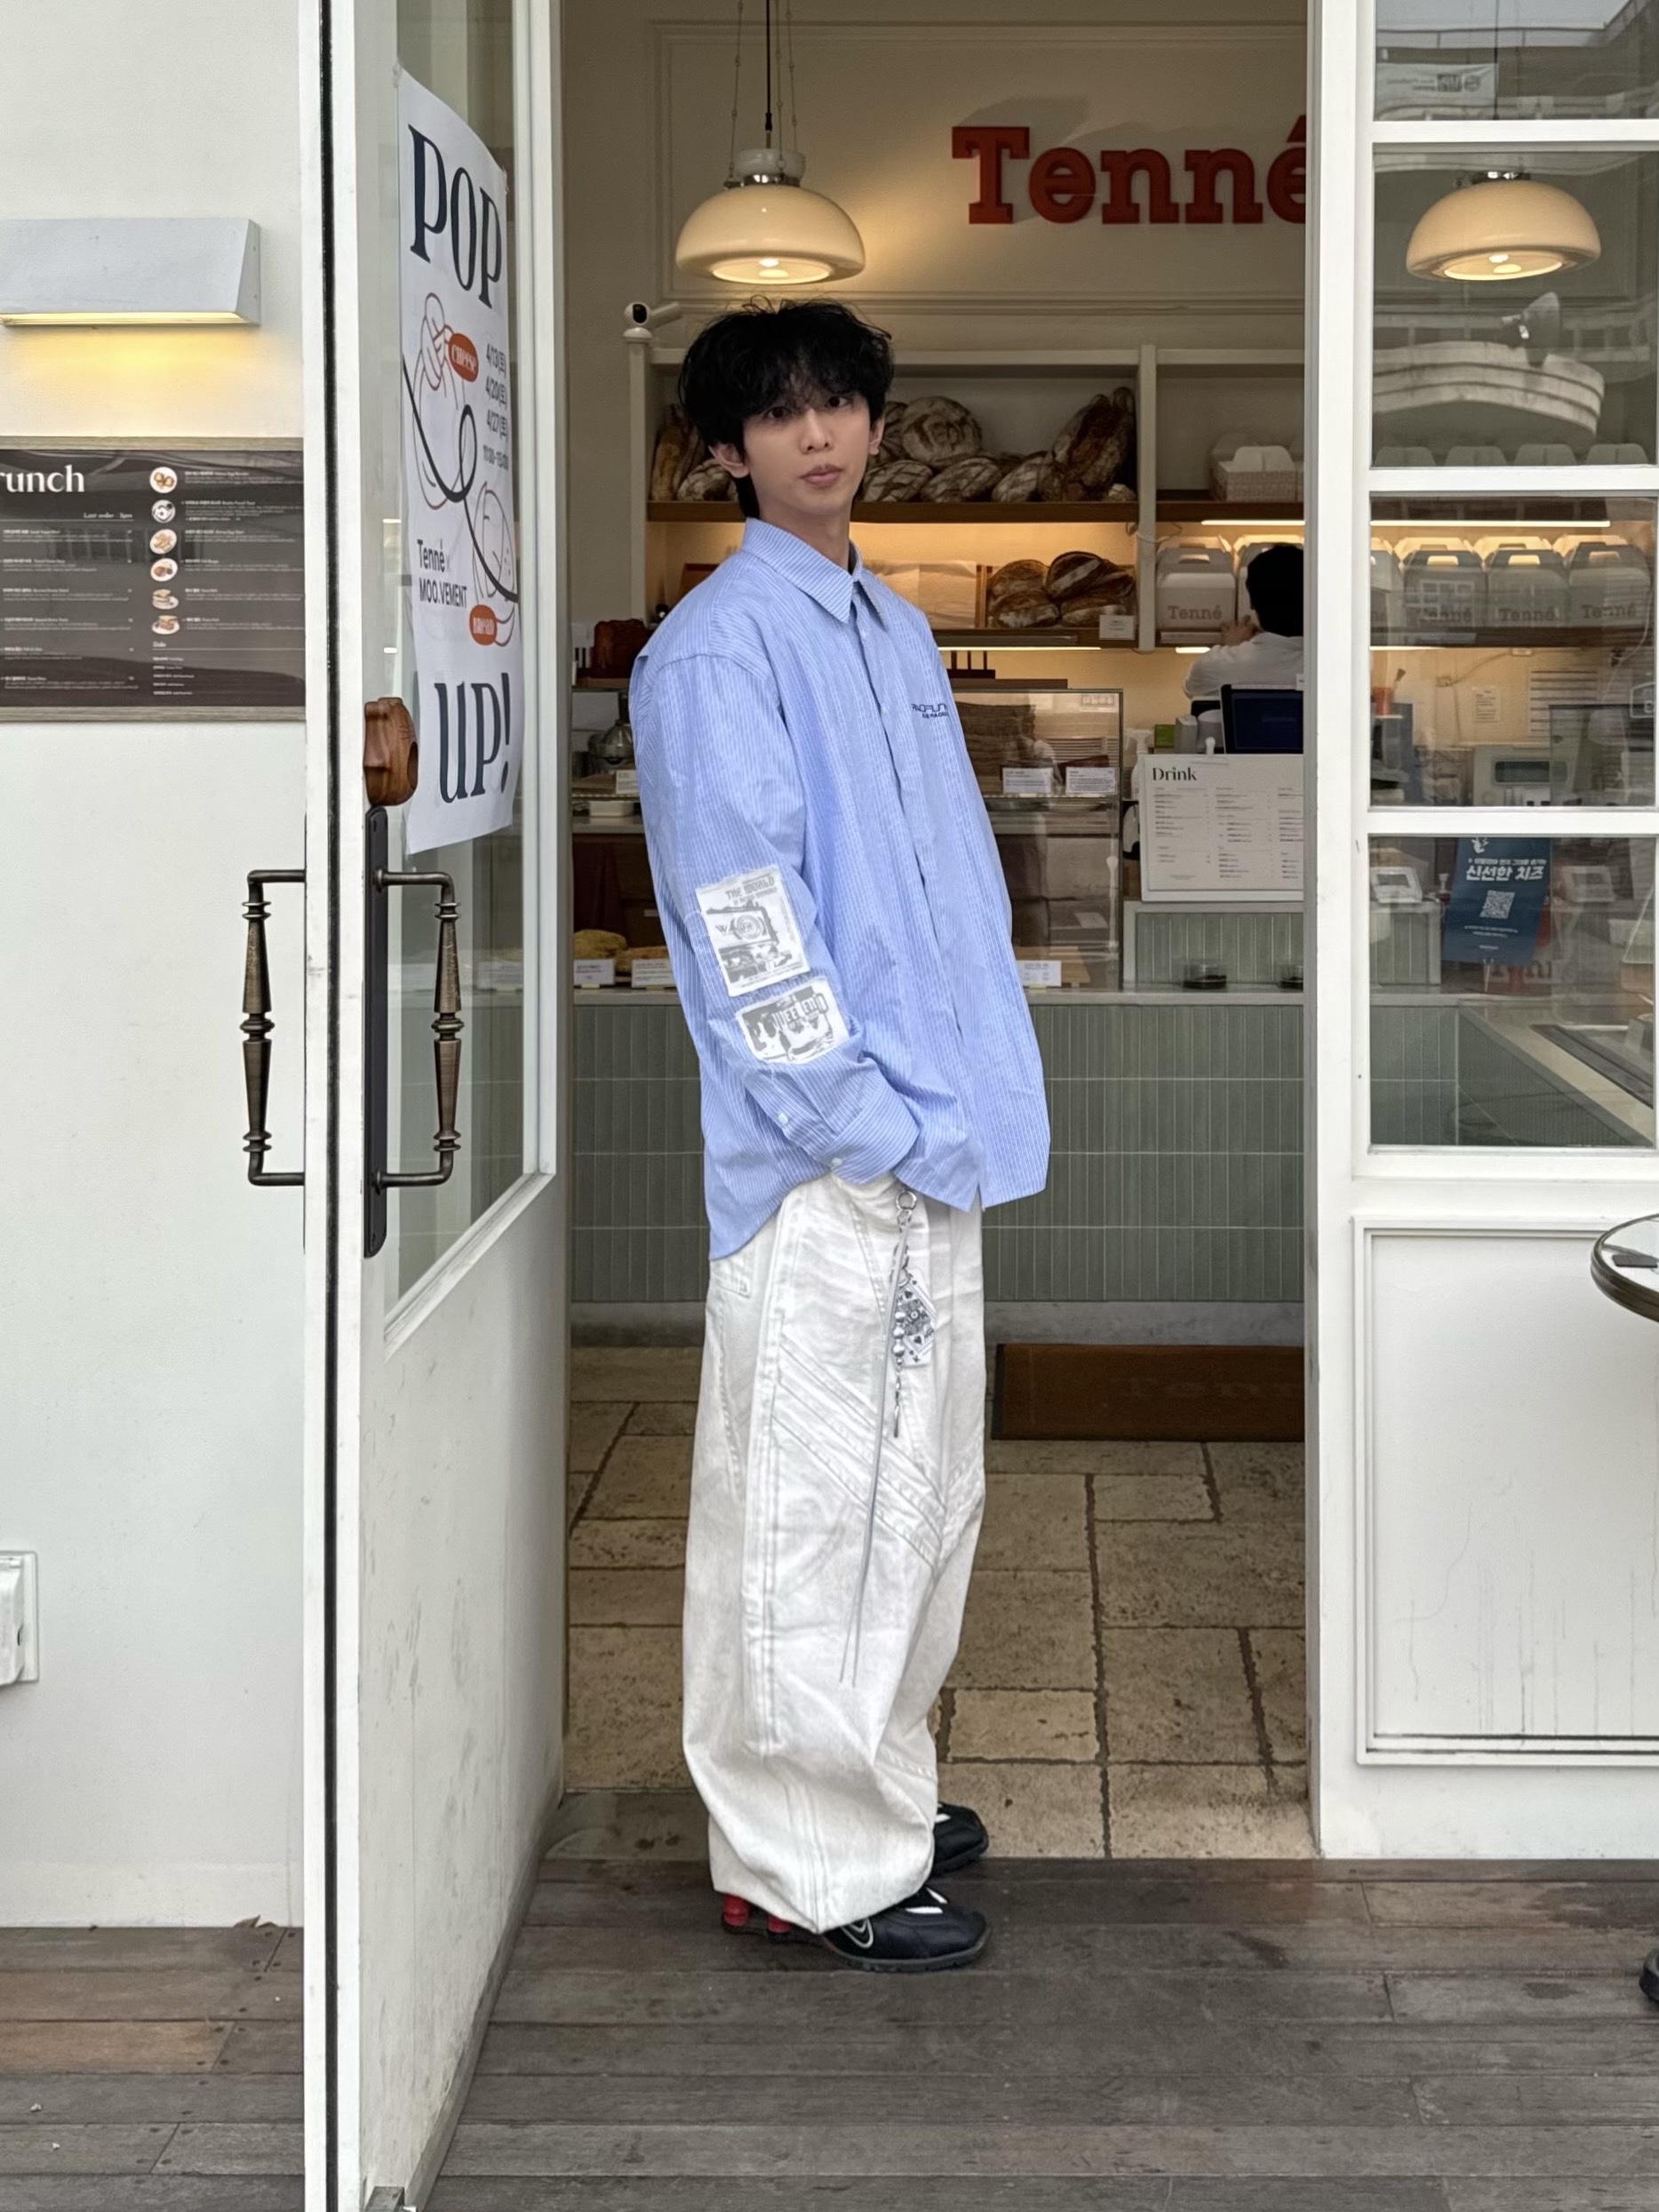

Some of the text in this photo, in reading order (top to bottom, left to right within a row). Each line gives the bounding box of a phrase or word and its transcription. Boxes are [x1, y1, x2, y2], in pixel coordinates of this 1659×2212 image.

[952, 115, 1306, 224] Tenné
[408, 123, 502, 309] POP
[1167, 605, 1223, 620] Tenné
[1152, 766, 1197, 781] Drink
[1465, 865, 1544, 882] 신선한 치즈
